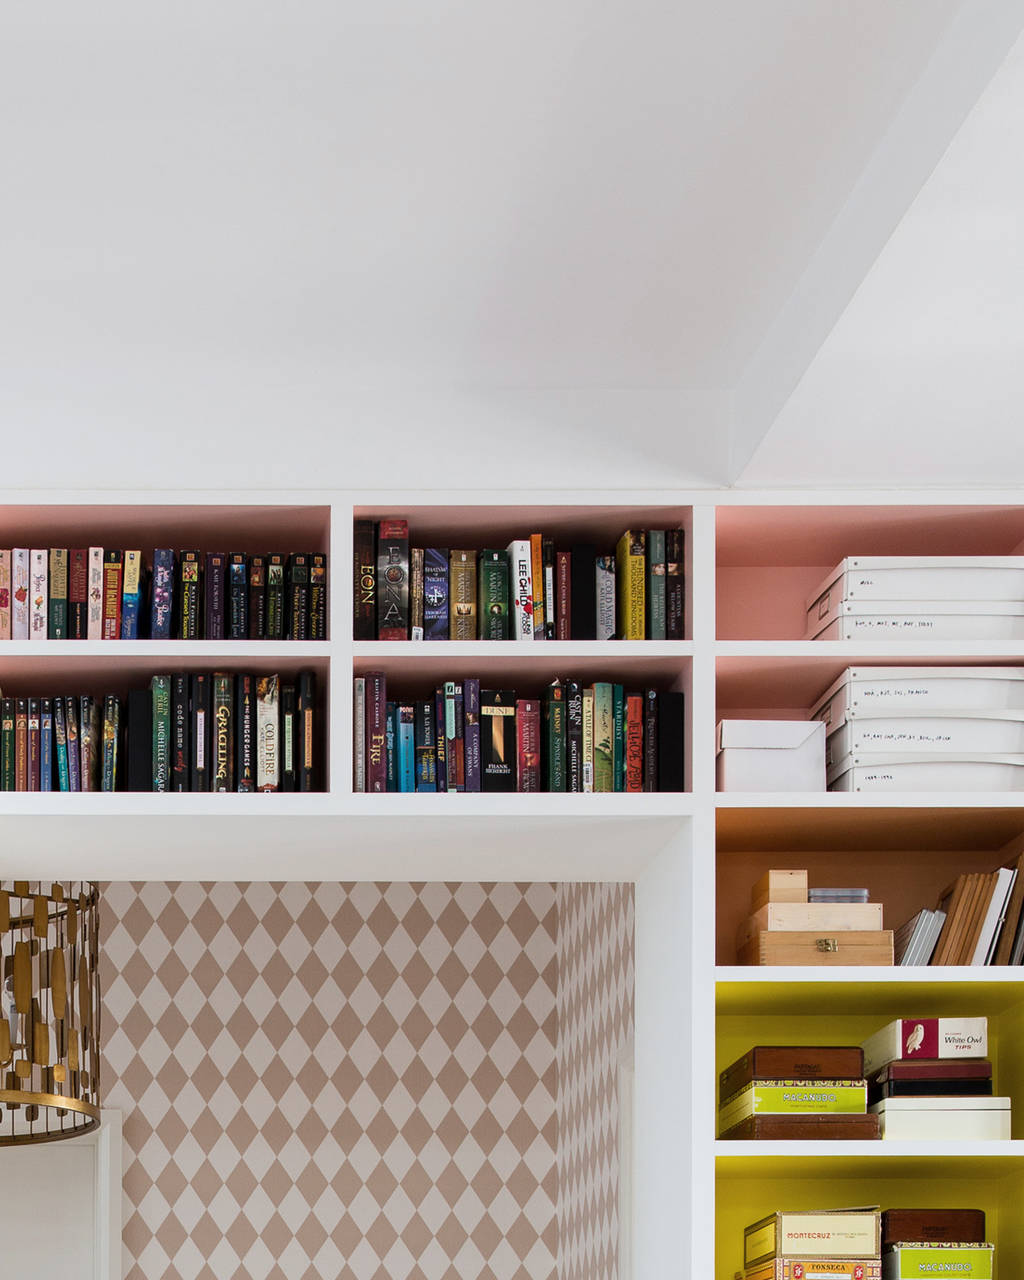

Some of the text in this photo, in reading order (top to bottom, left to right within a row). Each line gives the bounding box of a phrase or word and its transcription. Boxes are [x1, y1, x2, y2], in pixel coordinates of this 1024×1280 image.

[519, 559, 527, 576] LEE
[361, 565, 374, 604] EON
[919, 1263, 972, 1272] MACANUDO
